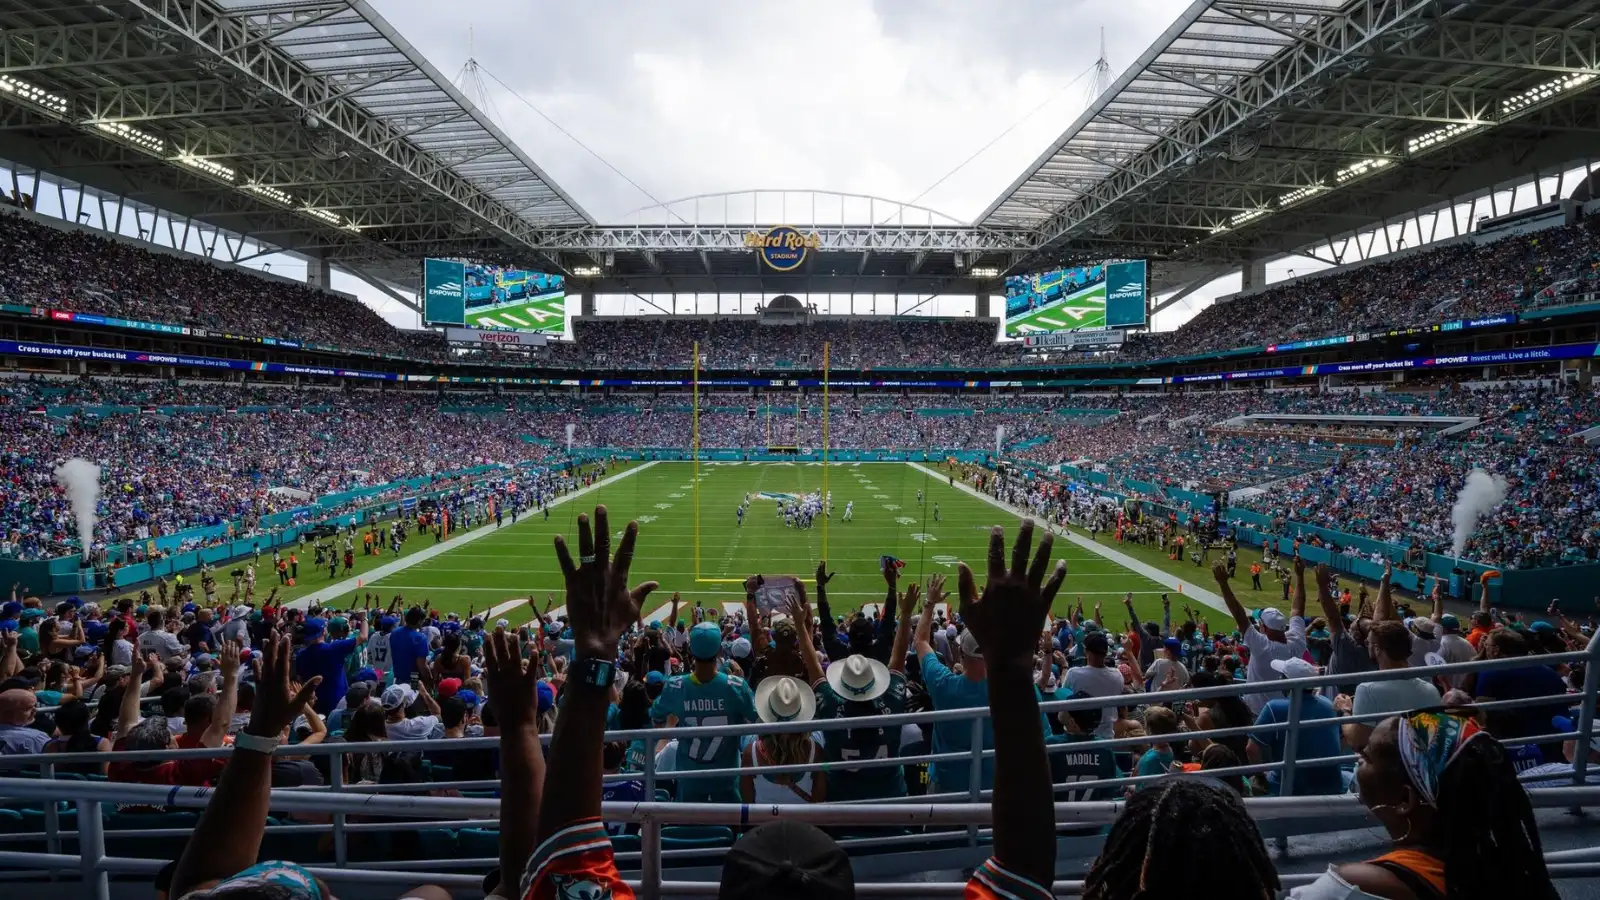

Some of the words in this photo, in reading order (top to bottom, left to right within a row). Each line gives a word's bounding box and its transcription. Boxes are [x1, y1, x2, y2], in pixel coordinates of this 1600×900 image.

[744, 231, 783, 247] Hard
[784, 231, 821, 250] Rock
[429, 289, 461, 297] EMPOWER
[1109, 291, 1142, 299] EMPOWER
[479, 331, 520, 343] verizon
[18, 344, 40, 353] Cross
[41, 347, 62, 355] more
[62, 348, 73, 356] off
[74, 350, 91, 358] your
[92, 350, 115, 359] bucket
[1435, 356, 1468, 365] EMPOWER
[1470, 354, 1491, 362] Invest
[1491, 352, 1507, 361] well.
[1508, 352, 1523, 360] Live
[1530, 350, 1551, 358] little.
[148, 355, 178, 363] EMPOWER
[375, 647, 387, 661] 17
[684, 698, 725, 711] WADDLE
[684, 715, 728, 763] 17
[1066, 753, 1100, 766] WADDLE
[1065, 774, 1099, 802] 17
